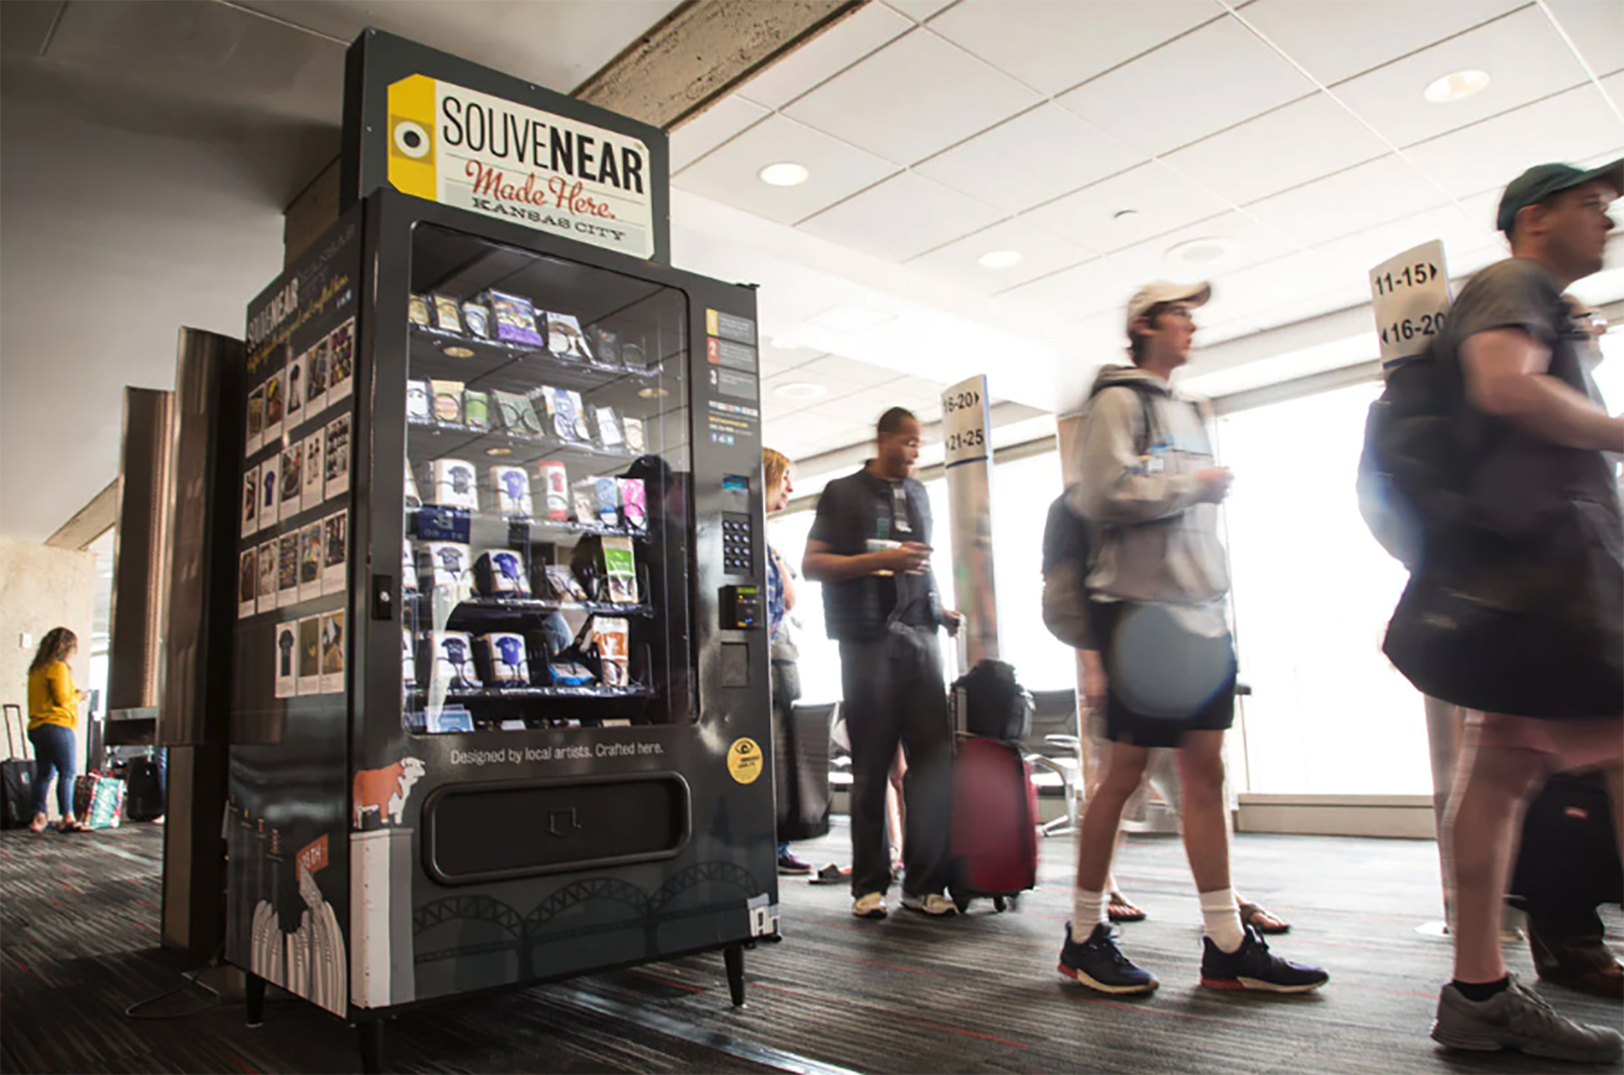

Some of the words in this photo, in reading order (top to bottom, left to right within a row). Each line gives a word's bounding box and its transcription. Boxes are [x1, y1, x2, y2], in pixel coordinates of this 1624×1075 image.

[442, 96, 645, 195] SOUVENEAR
[465, 159, 545, 207] Made
[548, 176, 616, 219] Here.
[472, 197, 571, 233] KANSAS
[574, 221, 627, 242] CITY
[1375, 263, 1427, 295] 11-15
[1391, 312, 1447, 342] 16-20
[709, 341, 717, 356] 2
[950, 428, 984, 451] 21-25
[450, 748, 505, 766] Designed
[508, 748, 522, 764] by
[525, 746, 552, 761] local
[554, 745, 593, 759] artists.
[595, 743, 635, 757] Crafted
[637, 742, 664, 754] here.
